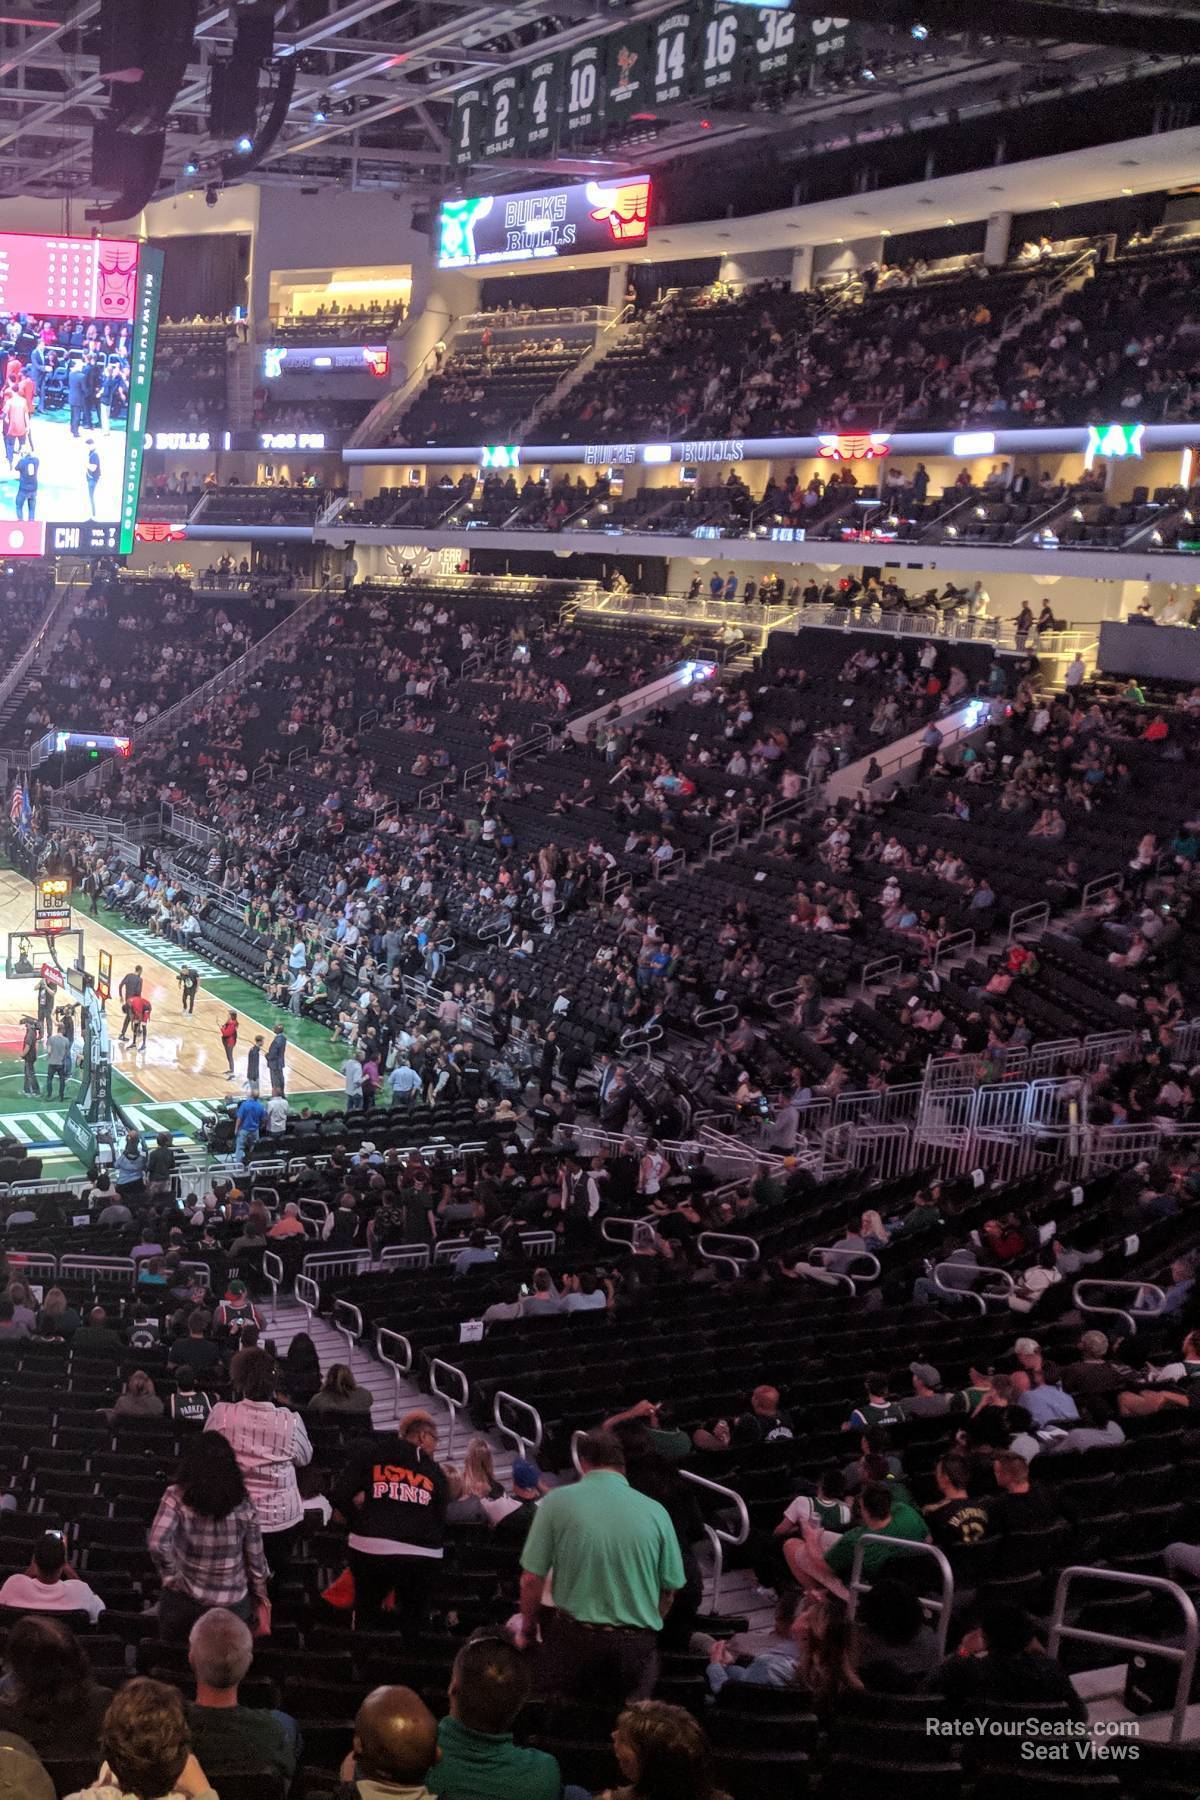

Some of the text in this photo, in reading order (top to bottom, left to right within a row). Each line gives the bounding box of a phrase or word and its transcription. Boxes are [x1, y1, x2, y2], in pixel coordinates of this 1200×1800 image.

[704, 15, 738, 70] 16
[756, 8, 795, 53] 32
[655, 32, 685, 85] 14
[533, 81, 548, 124] 4
[568, 64, 596, 113] 10
[461, 108, 470, 148] 1
[494, 95, 510, 137] 2
[505, 195, 567, 228] BUCKS
[506, 224, 576, 251] BULLS
[137, 273, 153, 385] MILWAUKEE
[156, 432, 210, 449] BULLS
[680, 440, 744, 462] BULLS
[8, 530, 25, 548] 0
[55, 528, 80, 548] CHI
[180, 1405, 204, 1416] PARKER
[373, 1464, 434, 1491] LOVE
[373, 1481, 433, 1507] PINK
